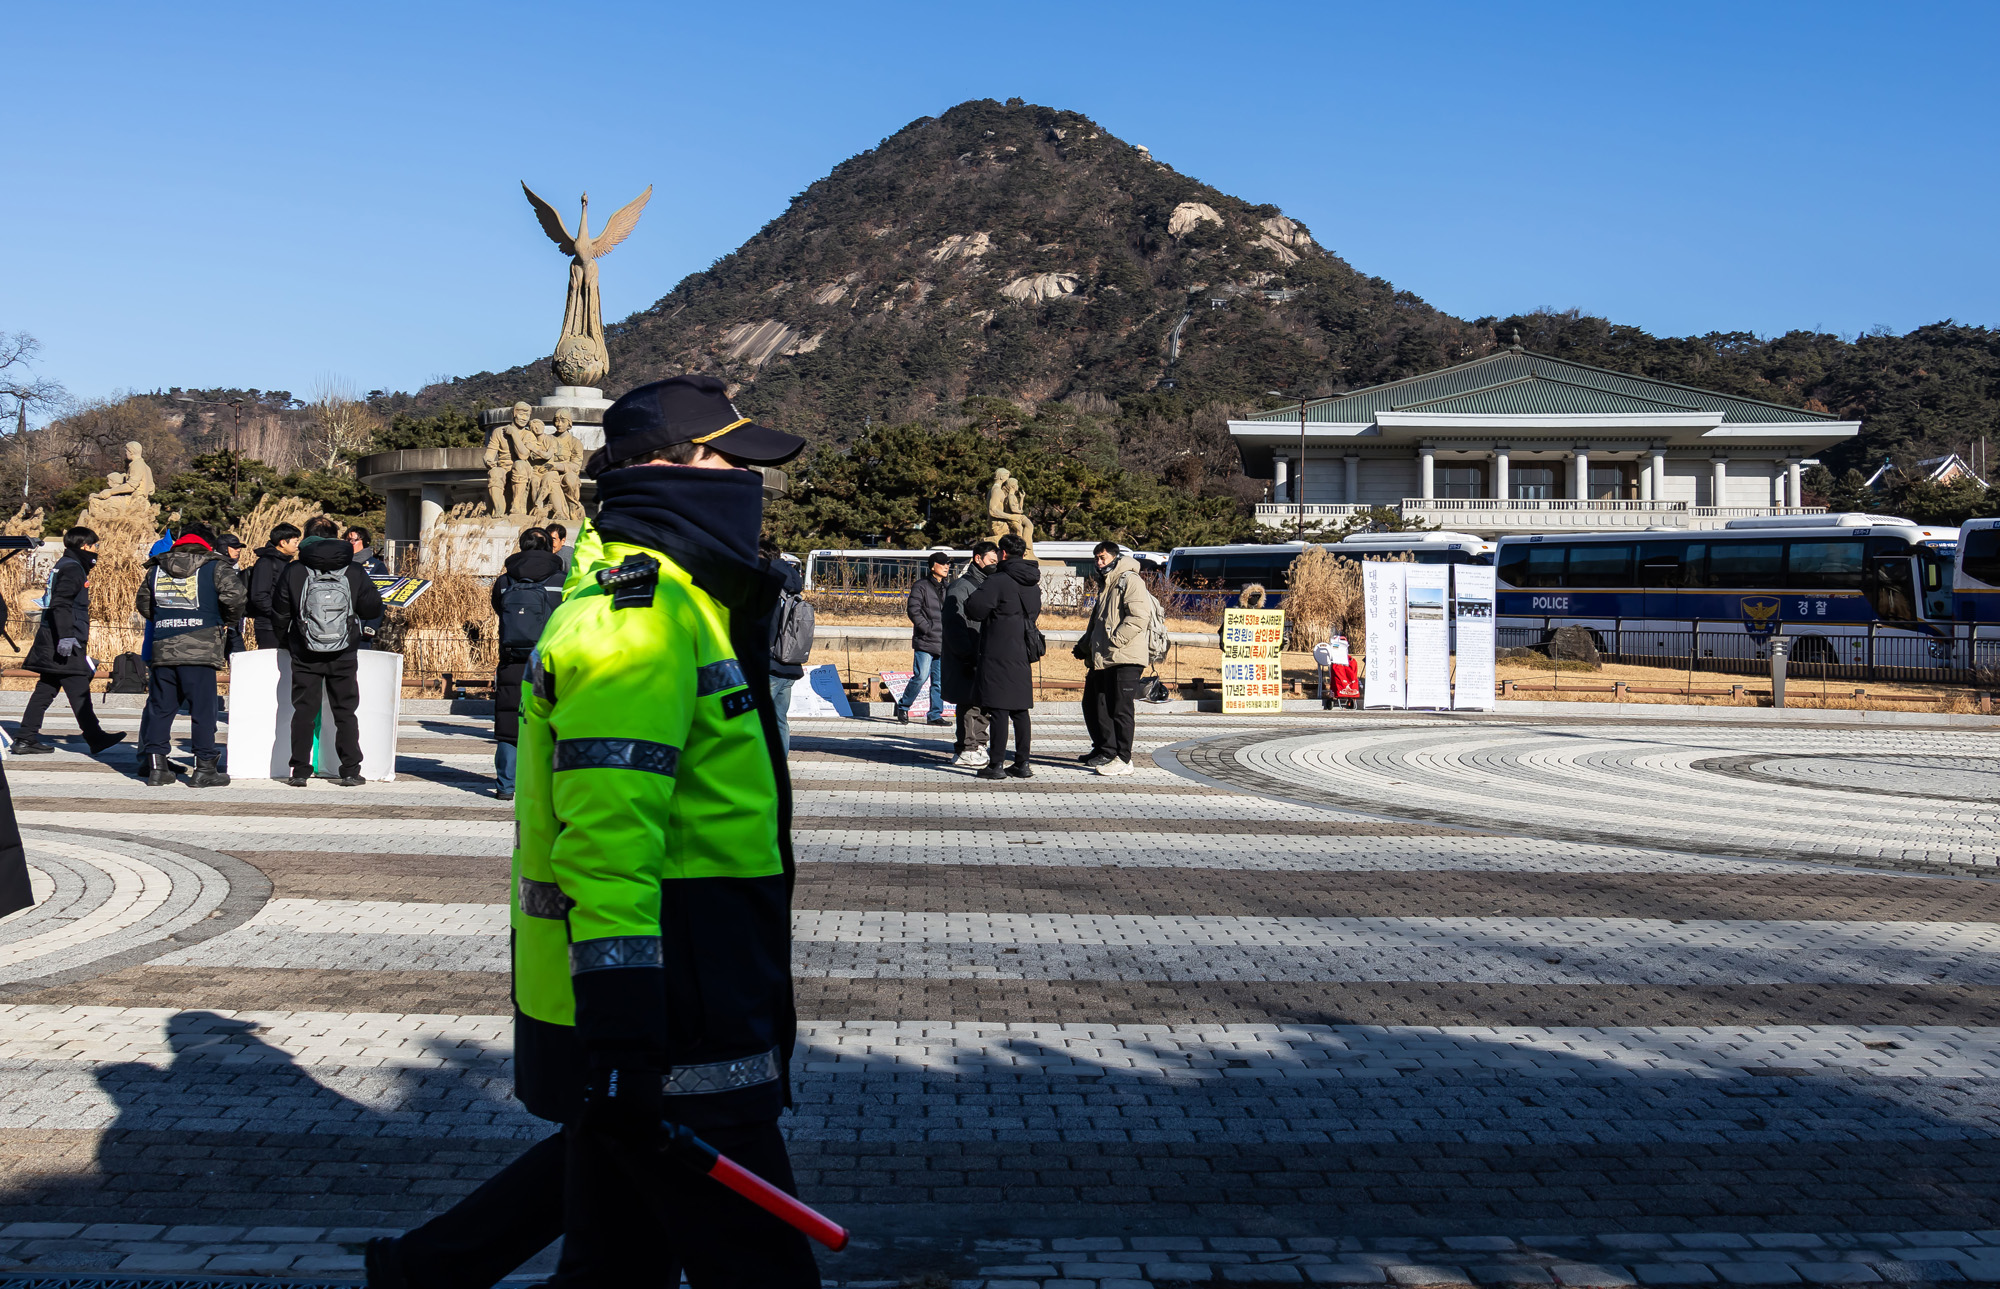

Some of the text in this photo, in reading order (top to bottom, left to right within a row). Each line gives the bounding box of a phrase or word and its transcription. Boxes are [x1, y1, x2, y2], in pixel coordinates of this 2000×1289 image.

[1532, 596, 1569, 609] POLICE
[1797, 600, 1828, 615] 경찰
[1228, 613, 1244, 625] 공수처
[1369, 569, 1379, 682] 대통령님 순국선열
[1226, 628, 1281, 643] 국정원의 살인청부
[1388, 582, 1398, 693] 추모관이 위기예요
[1225, 645, 1280, 659] 교통사고(즉사) 시도
[1225, 664, 1279, 681] 아파트 2동 강탈 시도
[1225, 684, 1246, 697] 17년간
[1262, 684, 1279, 697] 독극물
